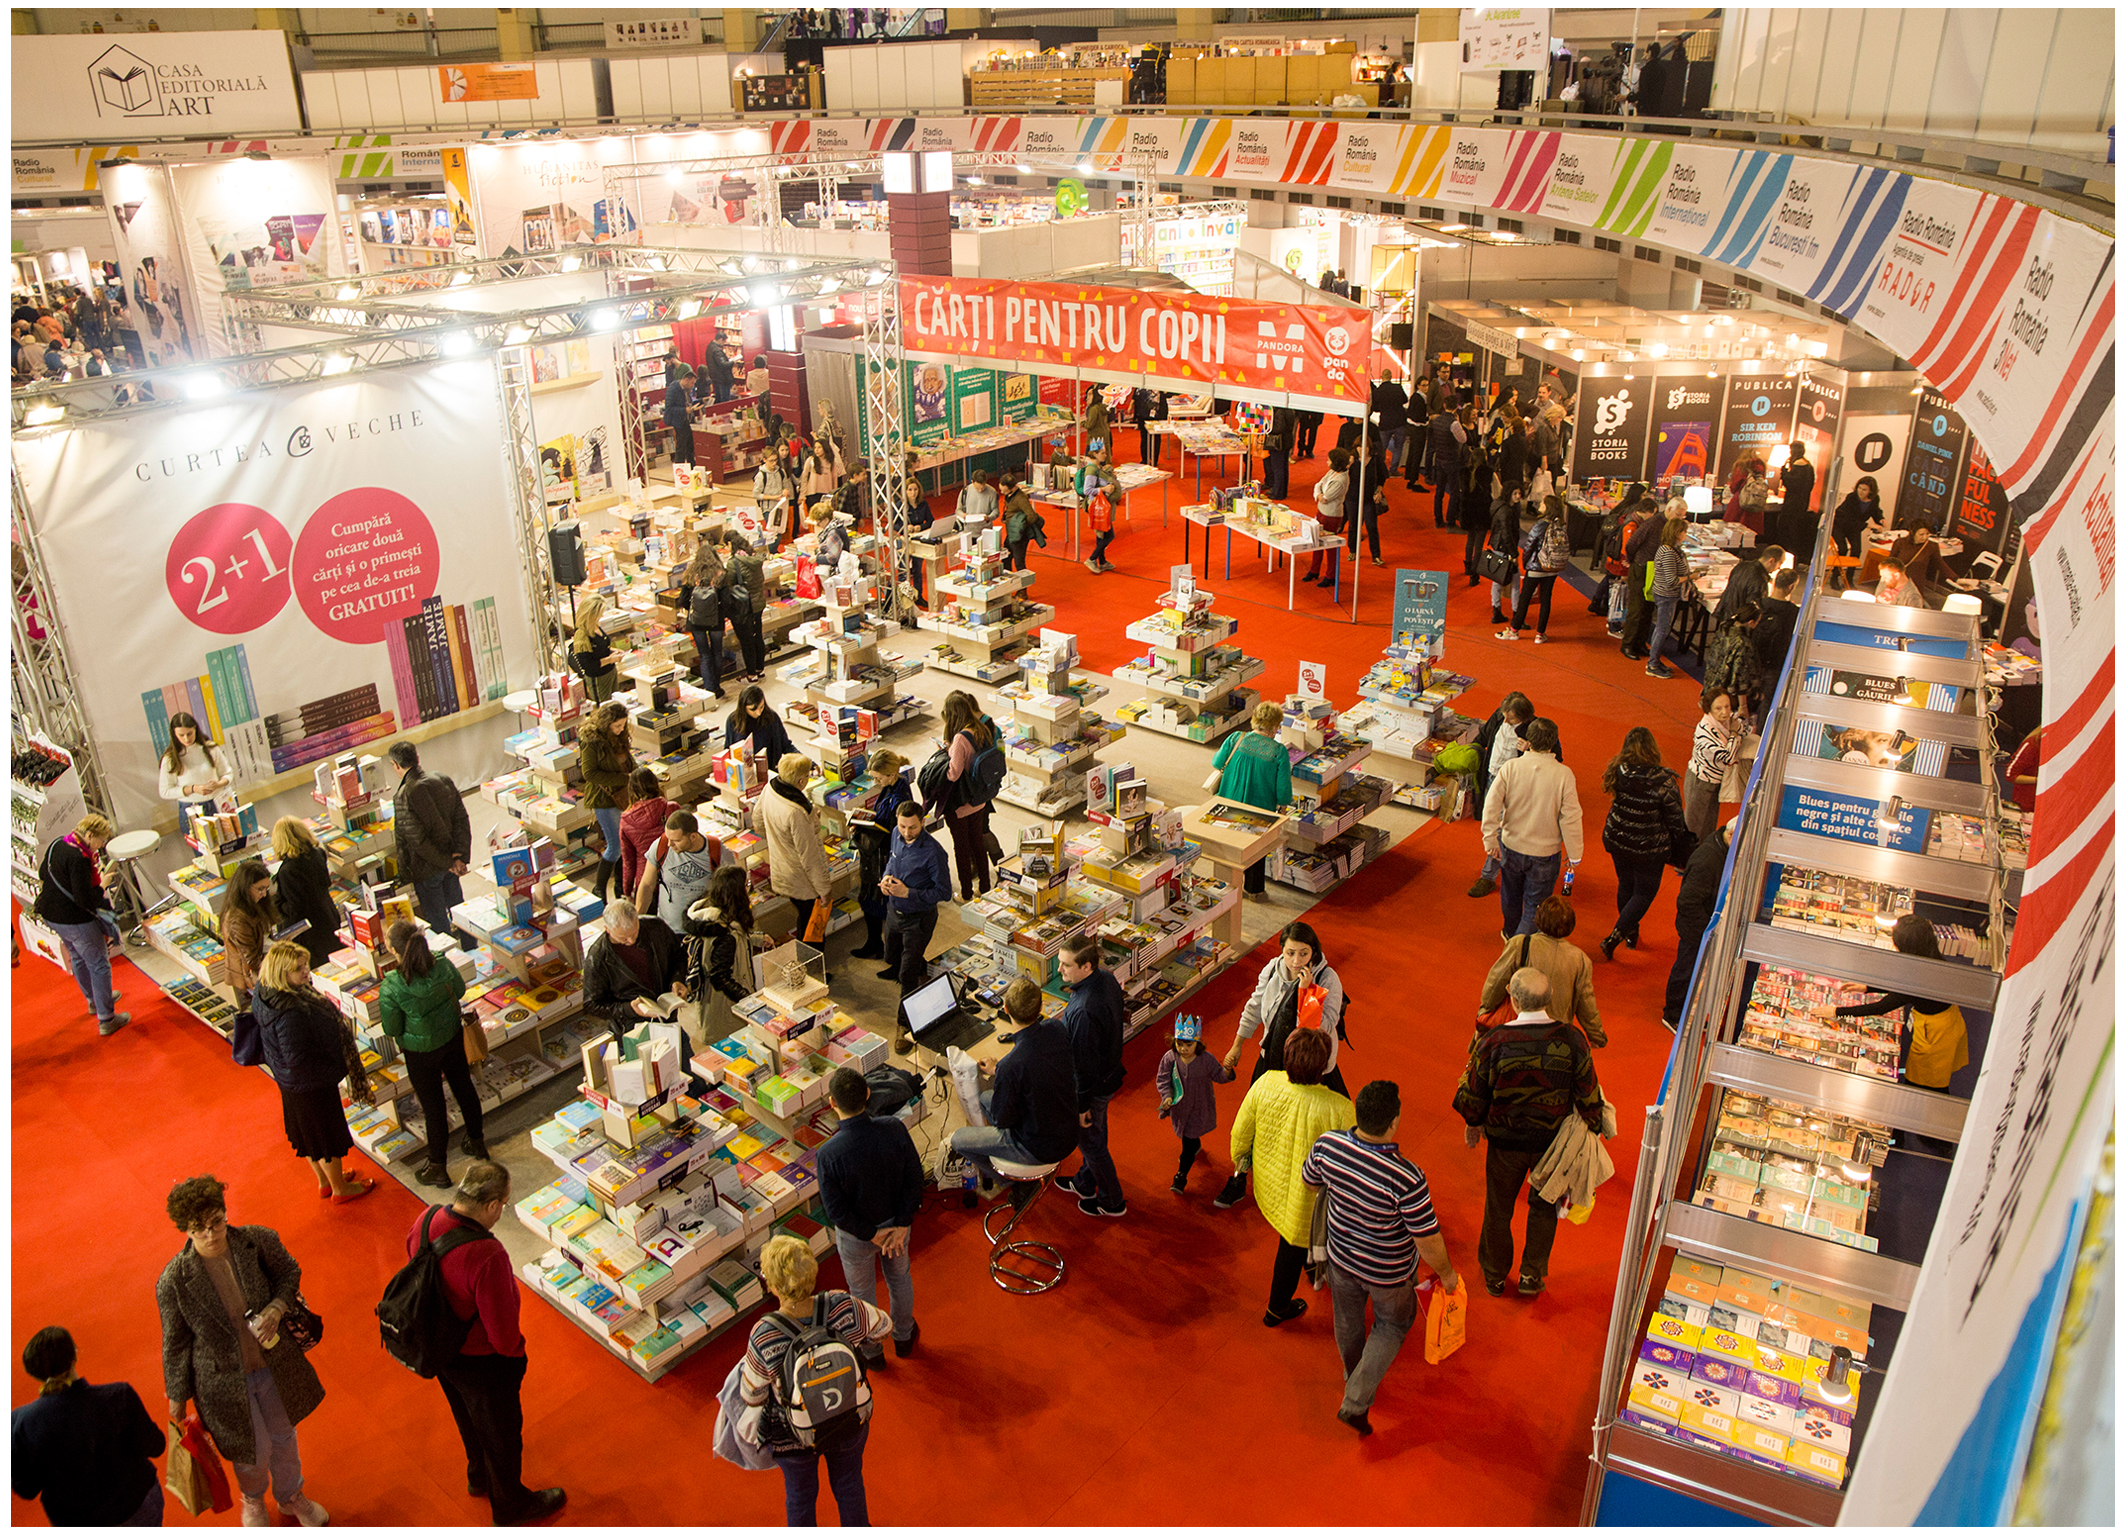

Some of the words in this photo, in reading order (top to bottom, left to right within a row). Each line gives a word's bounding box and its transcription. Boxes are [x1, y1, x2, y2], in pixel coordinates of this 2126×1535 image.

[157, 64, 203, 78] CASA
[162, 75, 268, 94] EDITORIALĂ
[167, 96, 215, 116] ART
[817, 128, 838, 137] Radio
[923, 128, 943, 136] Radio
[1027, 131, 1053, 143] Radio
[1133, 133, 1158, 145] Radio
[1238, 131, 1259, 142] Radio
[817, 138, 848, 146] România
[922, 137, 952, 146] România
[1237, 142, 1267, 154] România
[1348, 135, 1369, 147] Radio
[1456, 142, 1478, 156] Radio
[401, 150, 440, 158] Român
[402, 158, 440, 166] Interna
[1346, 148, 1377, 161] România
[1559, 153, 1579, 168] Radio
[13, 158, 40, 167] Radio
[1343, 161, 1372, 173] Cultural
[1453, 156, 1486, 172] România
[15, 167, 55, 175] România
[17, 175, 53, 183] Cultural
[1450, 170, 1478, 186] Muzical
[1554, 168, 1585, 185] România
[1672, 163, 1696, 182] Radio
[1550, 183, 1574, 200] Antena
[1573, 187, 1599, 204] Satelor
[1666, 183, 1701, 204] România
[1785, 180, 1811, 203] Radio
[1778, 202, 1814, 230] România
[1900, 210, 1924, 236] Radio
[1922, 216, 1956, 248] România
[2023, 255, 2054, 302] Radio
[1878, 262, 1936, 314] RADOR
[1006, 296, 1126, 353] PENTRU
[1140, 307, 1226, 364] COPII
[2007, 298, 2049, 357] România
[1257, 340, 1305, 353] PANDORA
[1323, 356, 1349, 369] pan
[1993, 339, 2019, 382] 3Net
[1327, 368, 1345, 381] da
[1735, 381, 1793, 390] PUBLICA
[1806, 382, 1840, 401] UBLICA
[1923, 394, 1958, 413] PUBLI
[1740, 423, 1755, 432] SIR
[1756, 422, 1777, 431] KEN
[1592, 439, 1628, 448] STORIA
[1732, 432, 1783, 442] ROBINSON
[135, 440, 273, 482] CURTEA
[325, 409, 423, 443] VECHE
[1917, 440, 1938, 454] DANIEL
[1938, 447, 1953, 459] PINK
[1590, 451, 1628, 460] BOOKS
[1910, 471, 1946, 496] CÂND
[1964, 478, 1990, 505] FUL
[1959, 500, 1997, 530] NESS
[331, 512, 392, 537] Cumpără
[325, 541, 370, 559] oricare
[372, 529, 404, 547] două
[180, 526, 288, 615] 2+1
[359, 561, 368, 570] o
[320, 588, 337, 604] pe
[340, 582, 361, 595] cea
[363, 573, 391, 588] de-a
[393, 564, 421, 580] treia
[329, 583, 416, 621] GRATUIT!
[1412, 607, 1434, 615] IARNĂ
[423, 604, 439, 651] JAMIE
[432, 602, 449, 648] JAMIE
[1874, 634, 1898, 646] TRe
[1865, 679, 1896, 690] BLUES
[1856, 689, 1898, 702] GĂURIL
[1796, 807, 1829, 820] negre
[1843, 814, 1866, 826] alte
[1799, 794, 1830, 809] Blues
[1832, 802, 1870, 816] pentru
[1872, 809, 1914, 823] gile
[1801, 819, 1819, 830] din
[1862, 831, 1902, 844] cosic
